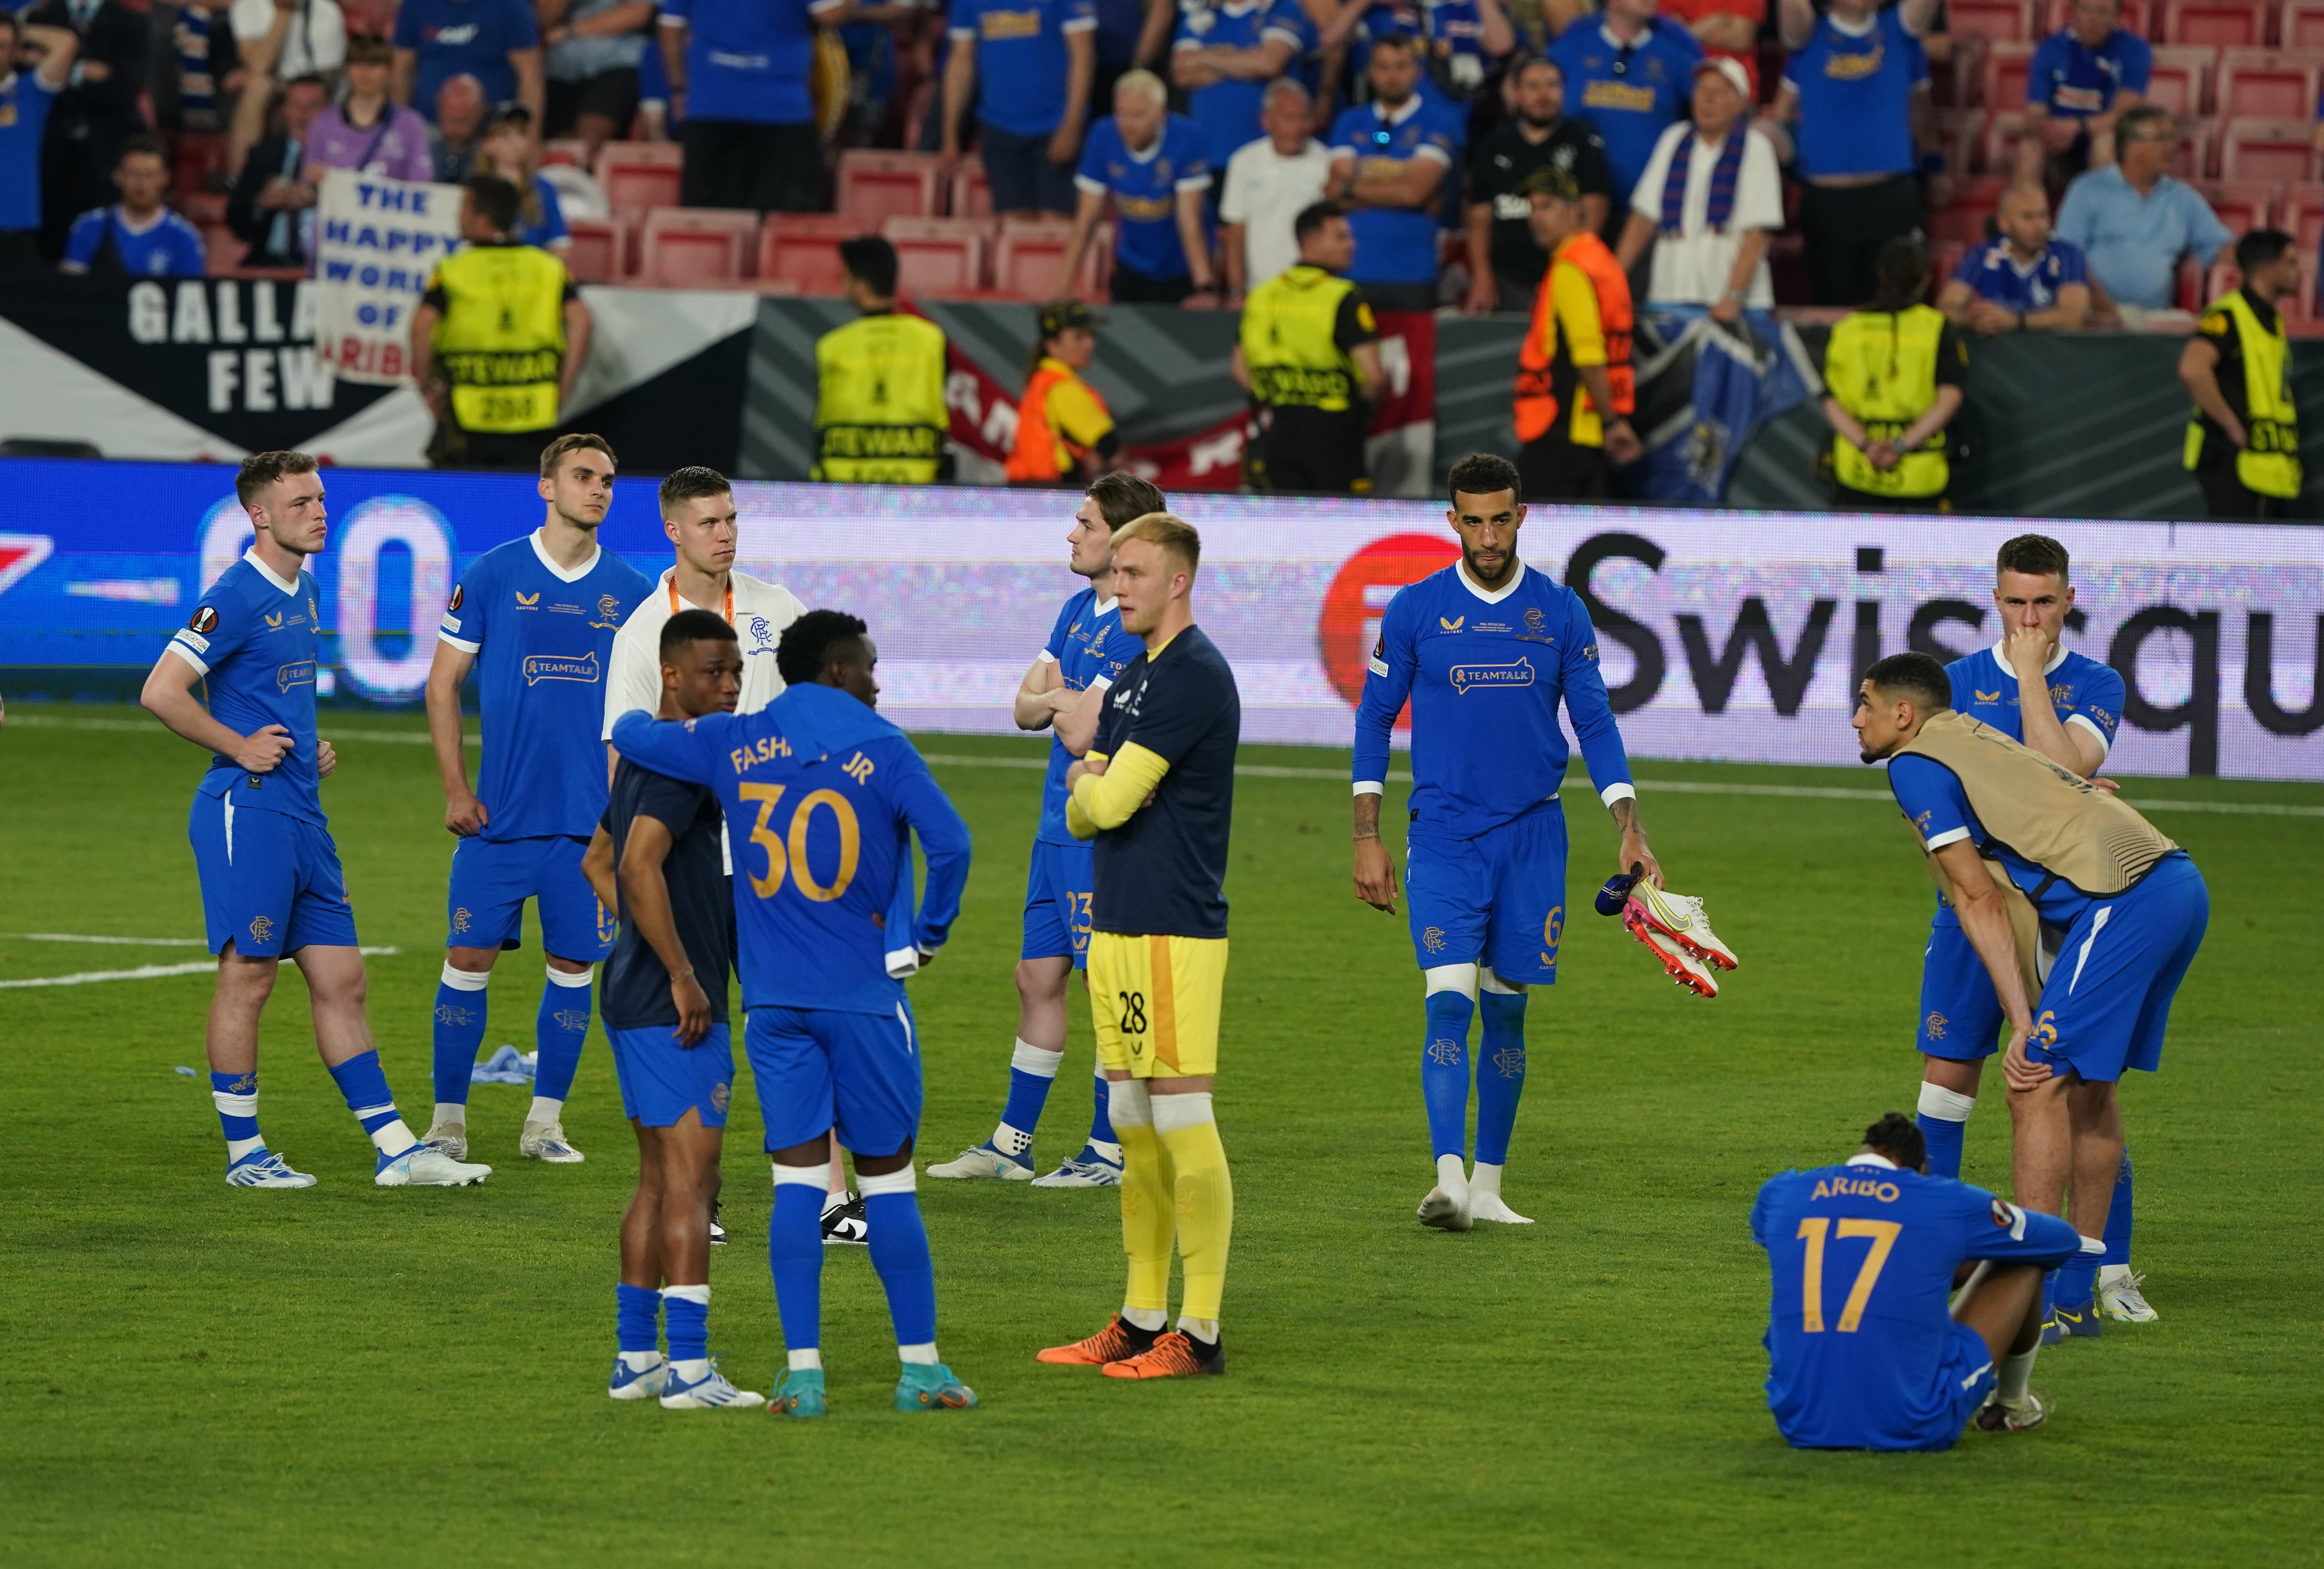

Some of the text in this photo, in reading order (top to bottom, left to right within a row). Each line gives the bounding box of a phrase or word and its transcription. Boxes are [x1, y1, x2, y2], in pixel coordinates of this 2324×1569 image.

[357, 184, 428, 214] THE
[327, 220, 457, 254] HAPPY
[357, 304, 402, 326] OF
[207, 348, 335, 413] FEW
[538, 663, 594, 675] TEAMTALK
[1468, 671, 1528, 681] TEAMTALK
[842, 751, 875, 786] JR
[739, 781, 861, 902] 30
[1066, 891, 1092, 934] 23
[1544, 906, 1562, 948] 6
[1120, 991, 1147, 1034] 28
[1810, 1176, 1900, 1203] ARIBO
[1796, 1217, 1903, 1333] 17
